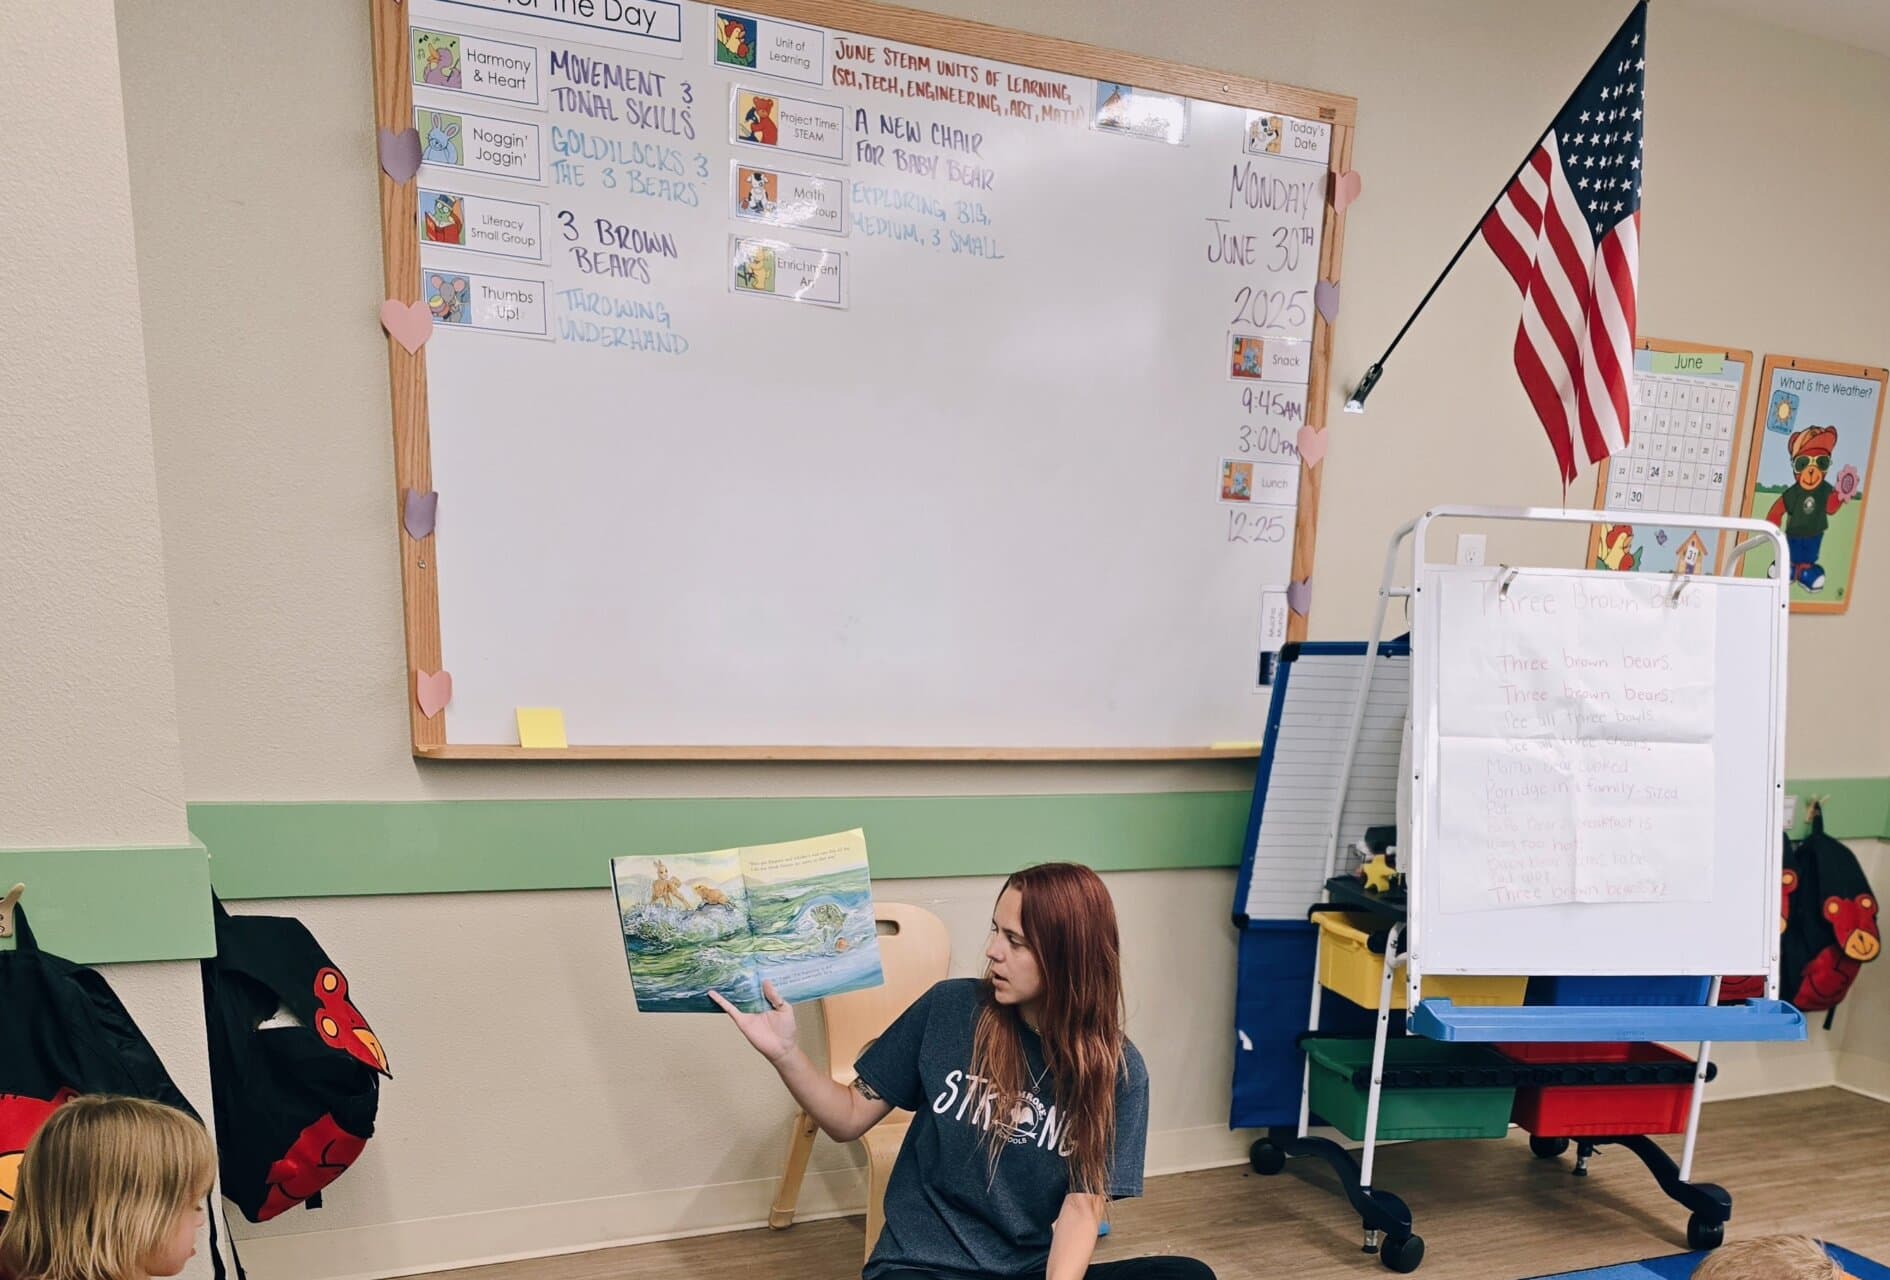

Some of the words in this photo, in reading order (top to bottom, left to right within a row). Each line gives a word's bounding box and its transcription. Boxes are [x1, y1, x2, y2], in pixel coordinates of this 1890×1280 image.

[604, 0, 657, 33] Day
[776, 36, 793, 49] Unit
[795, 40, 805, 52] of
[467, 48, 531, 72] Harmony
[769, 50, 811, 70] Learning
[833, 37, 876, 63] JUNE
[884, 47, 931, 74] STEAM
[937, 59, 979, 83] UNITS
[985, 69, 1002, 87] OF
[1007, 73, 1072, 105] LEARNING
[473, 69, 485, 84] &
[488, 72, 526, 89] Heart
[550, 50, 665, 98] MOVEMENT
[550, 86, 618, 121] TONAL
[627, 97, 696, 140] SKILLS
[781, 111, 813, 126] Project
[473, 127, 528, 149] Noggin'
[794, 128, 825, 143] STEAM
[855, 108, 869, 135] A
[880, 114, 921, 143] NEW
[931, 122, 983, 159] CHAIR
[1289, 119, 1326, 138] Today's
[551, 125, 685, 177] GOLDILOCKS
[1294, 137, 1318, 152] Date
[475, 147, 528, 168] Joggin'
[857, 139, 885, 167] FOR
[893, 148, 939, 179] BABY
[947, 159, 994, 191] BEAR
[551, 159, 585, 188] THE
[602, 167, 617, 189] 3
[627, 169, 699, 207] BEARS
[794, 186, 825, 203] Math
[1229, 161, 1314, 220] MONDAY
[482, 214, 524, 232] Literacy
[815, 206, 838, 220] roup
[471, 229, 499, 242] Small
[503, 231, 536, 248] Group
[557, 210, 579, 242] 3
[595, 218, 678, 260] BROWN
[950, 229, 1005, 260] SMALL
[1205, 218, 1257, 266] JUNE
[568, 246, 650, 285] BEARS
[482, 284, 534, 305] Thumbs
[496, 303, 520, 322] Up!
[554, 286, 671, 329] THROWING
[1231, 286, 1308, 330] 2025
[558, 316, 690, 355] UNDERHAND
[1272, 353, 1300, 367] Snack
[1674, 353, 1703, 370] June
[1780, 375, 1805, 391] What
[1806, 379, 1813, 393] is
[1815, 380, 1830, 394] the
[1832, 382, 1873, 399] Weather?
[1261, 477, 1288, 490] Lunch
[1650, 466, 1660, 478] 24
[1712, 472, 1723, 484] 28
[1631, 491, 1642, 503] 30
[1227, 509, 1287, 544] 12:25
[1687, 550, 1697, 561] 31
[1496, 654, 1551, 673] Three
[1562, 648, 1609, 669] brown
[1498, 684, 1549, 705] Three
[1562, 680, 1611, 700] brown
